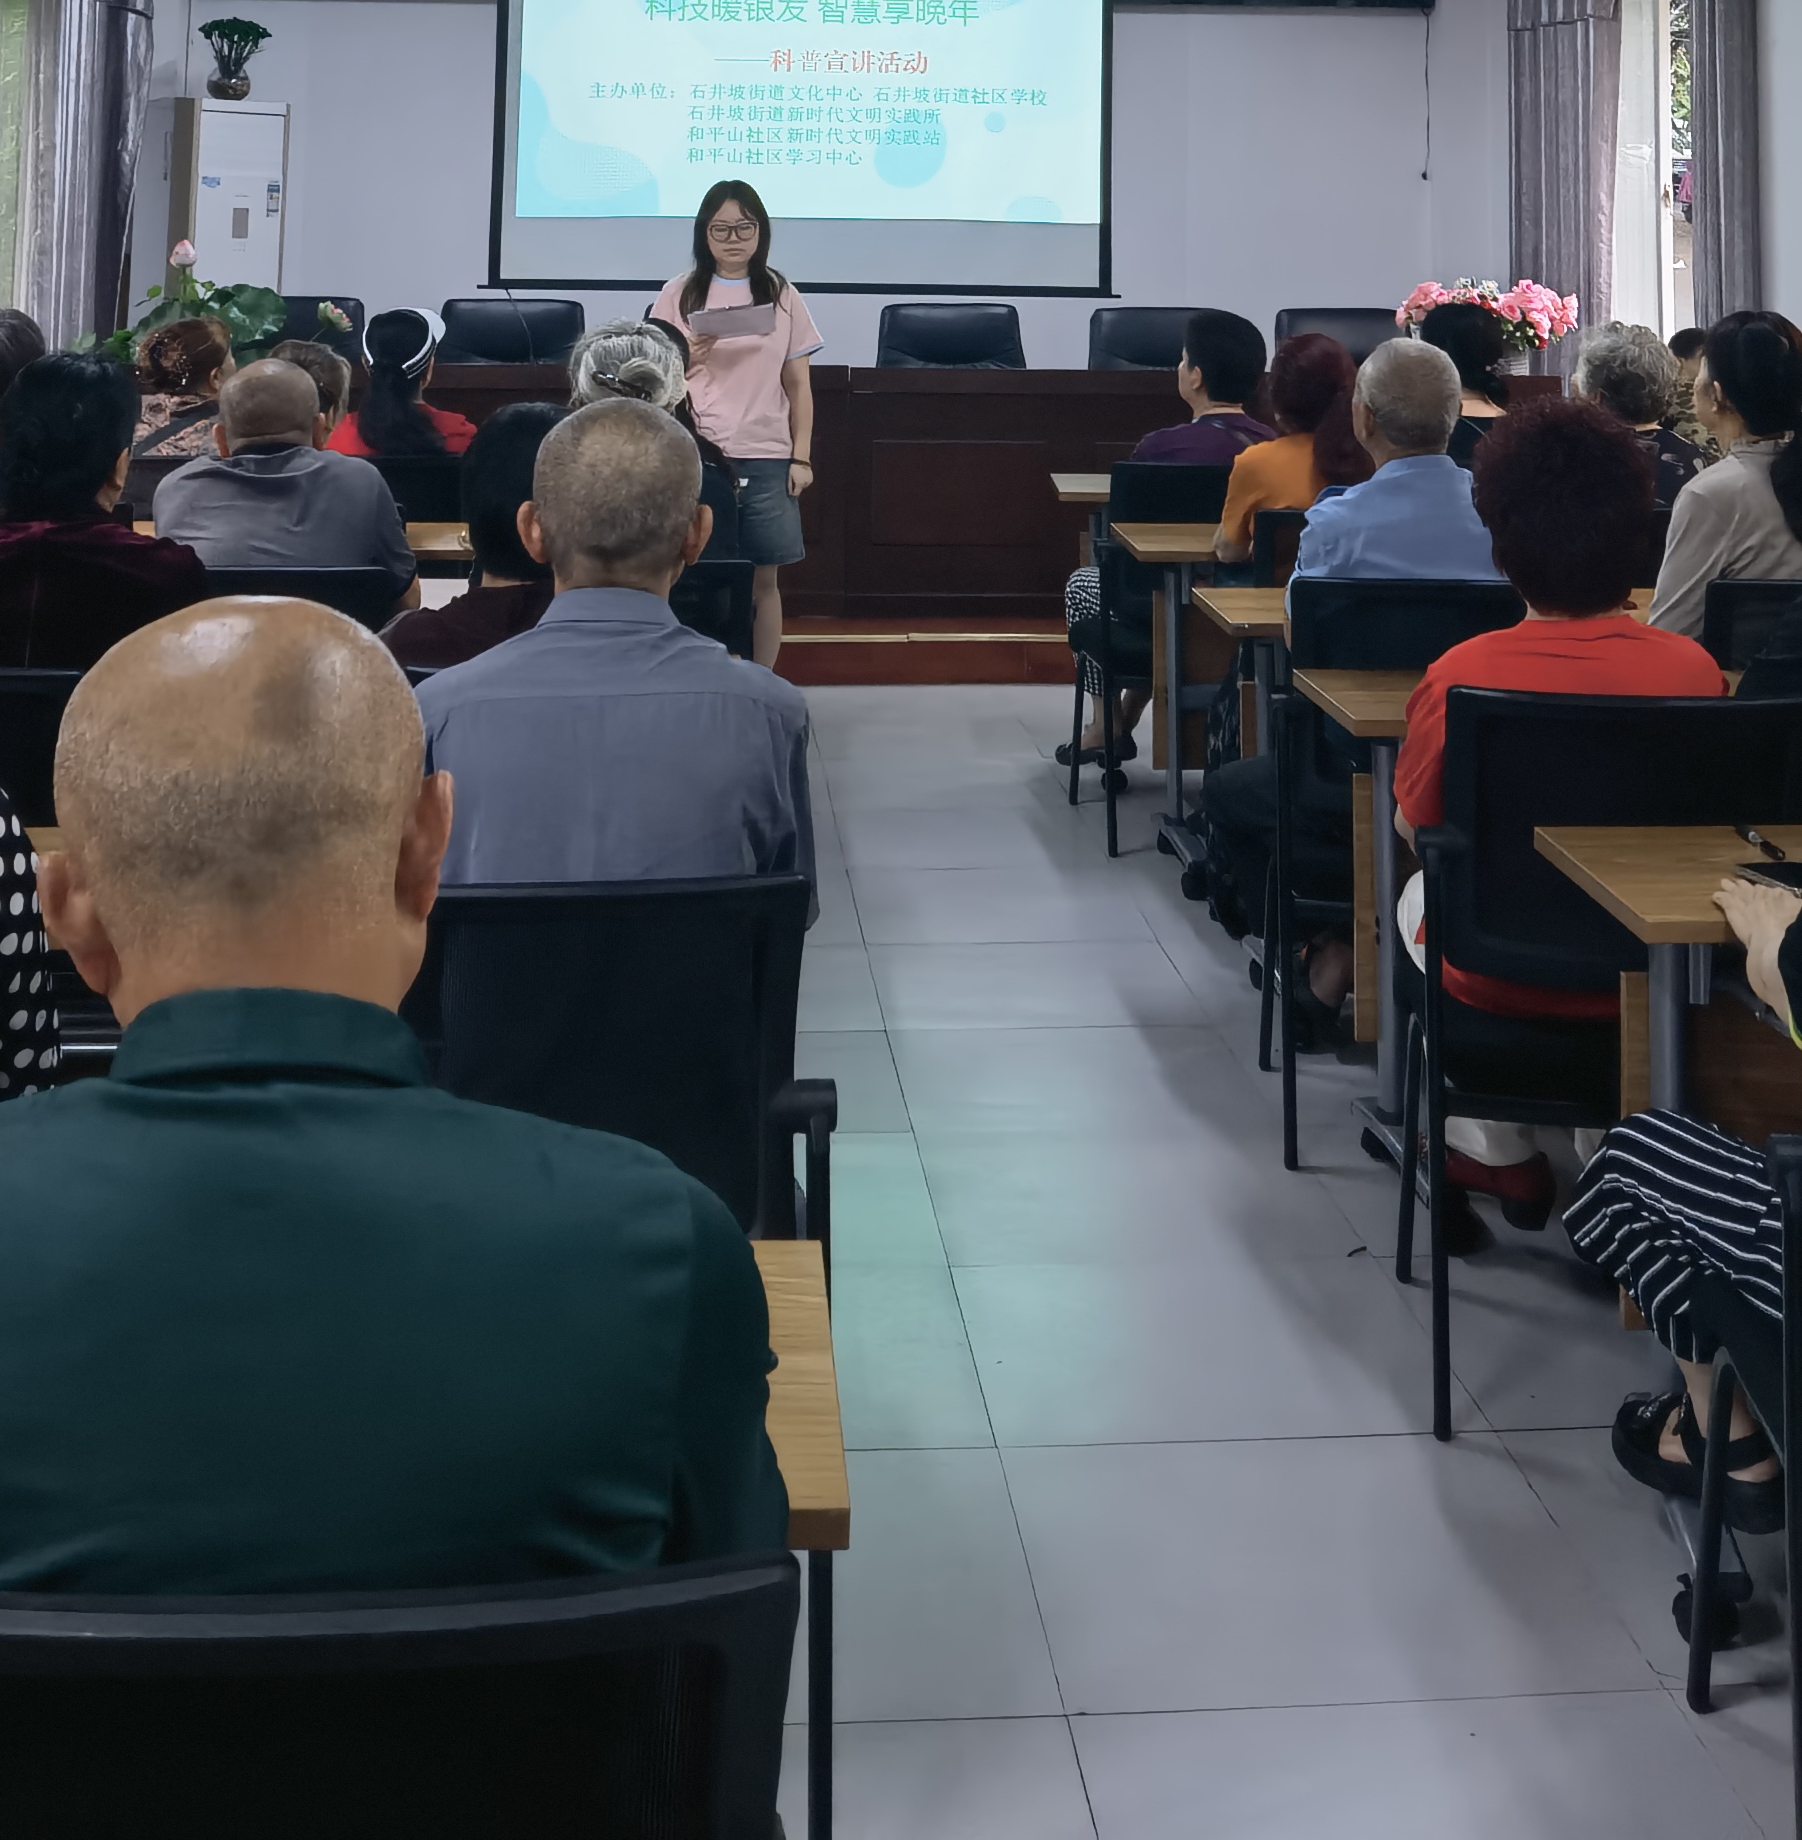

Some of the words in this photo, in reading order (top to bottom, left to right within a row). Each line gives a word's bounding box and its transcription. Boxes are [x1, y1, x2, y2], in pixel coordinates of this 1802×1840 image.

[589, 82, 676, 100] 主办单位：
[690, 83, 863, 103] 石井坡街道文化中心
[873, 86, 1048, 107] 石井坡街道社区学校
[688, 104, 942, 125] 石井坡街道新时代文明实践所
[687, 126, 941, 146] 和平山社区新时代文明实践站
[687, 147, 863, 166] 和平山社区学习中心
